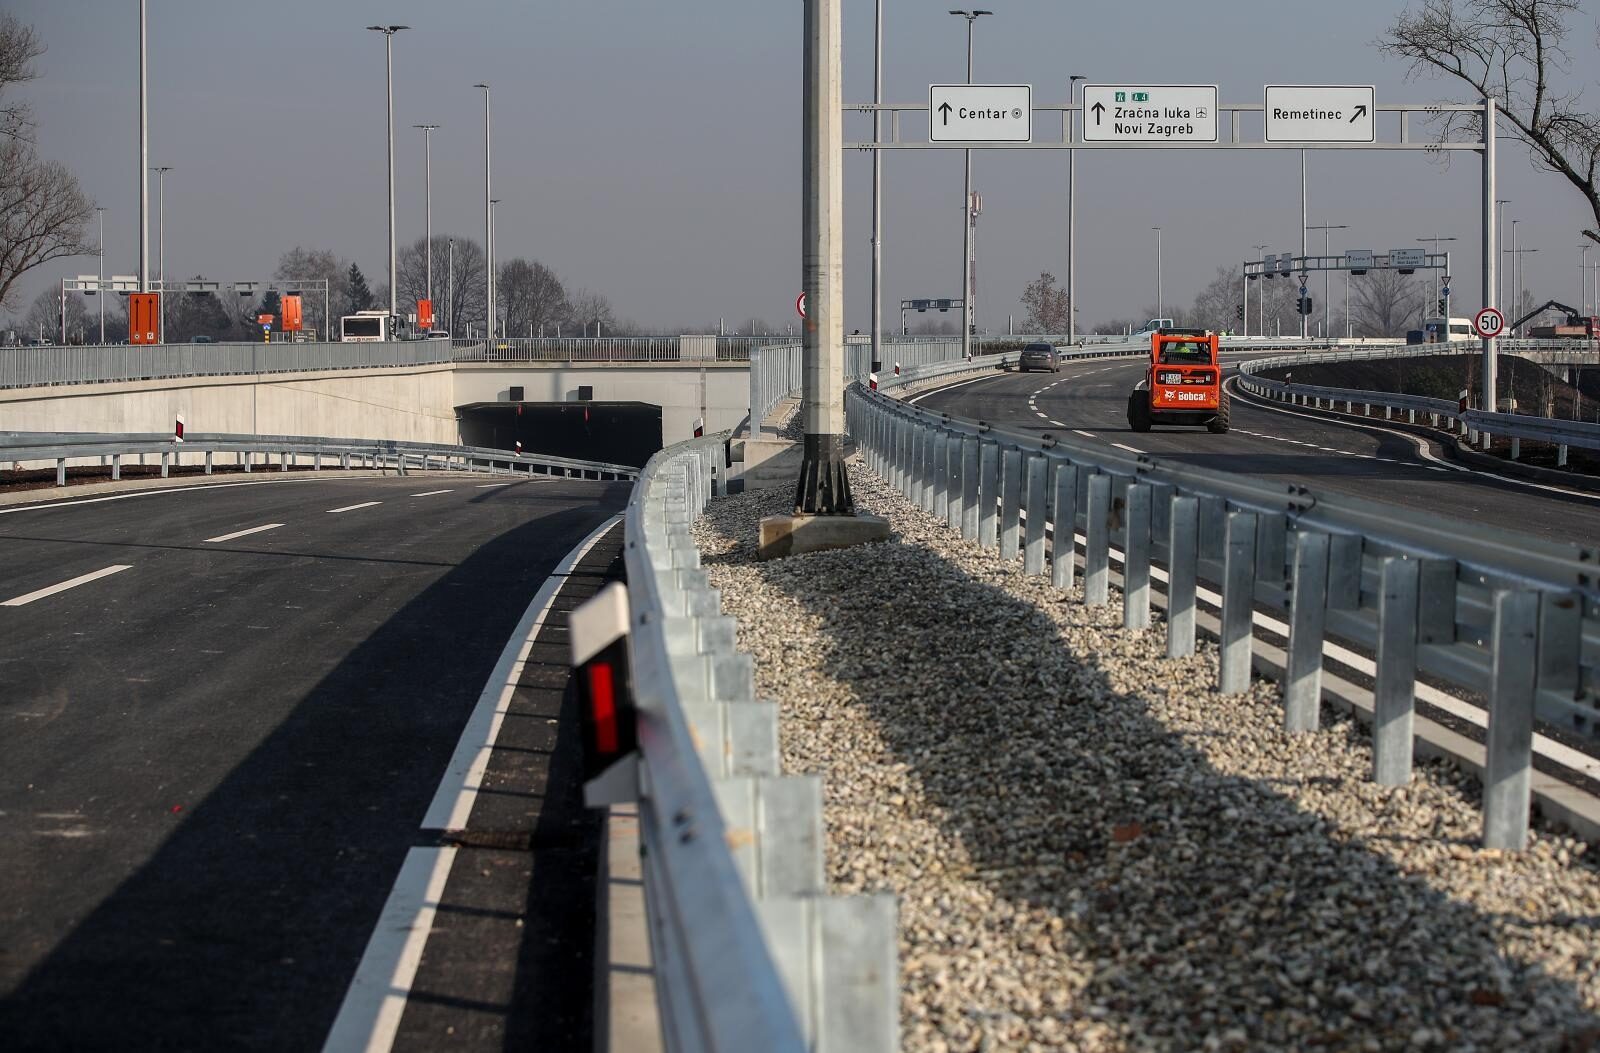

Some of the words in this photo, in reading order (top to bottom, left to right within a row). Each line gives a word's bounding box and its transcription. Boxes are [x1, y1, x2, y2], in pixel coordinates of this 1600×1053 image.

[959, 107, 1008, 119] Centar
[1114, 107, 1159, 119] Zračna
[1164, 107, 1191, 119] luka
[1273, 108, 1342, 120] Remetinec
[1114, 122, 1142, 134] Novi
[1147, 122, 1194, 137] Zagreb
[1481, 315, 1498, 331] 50
